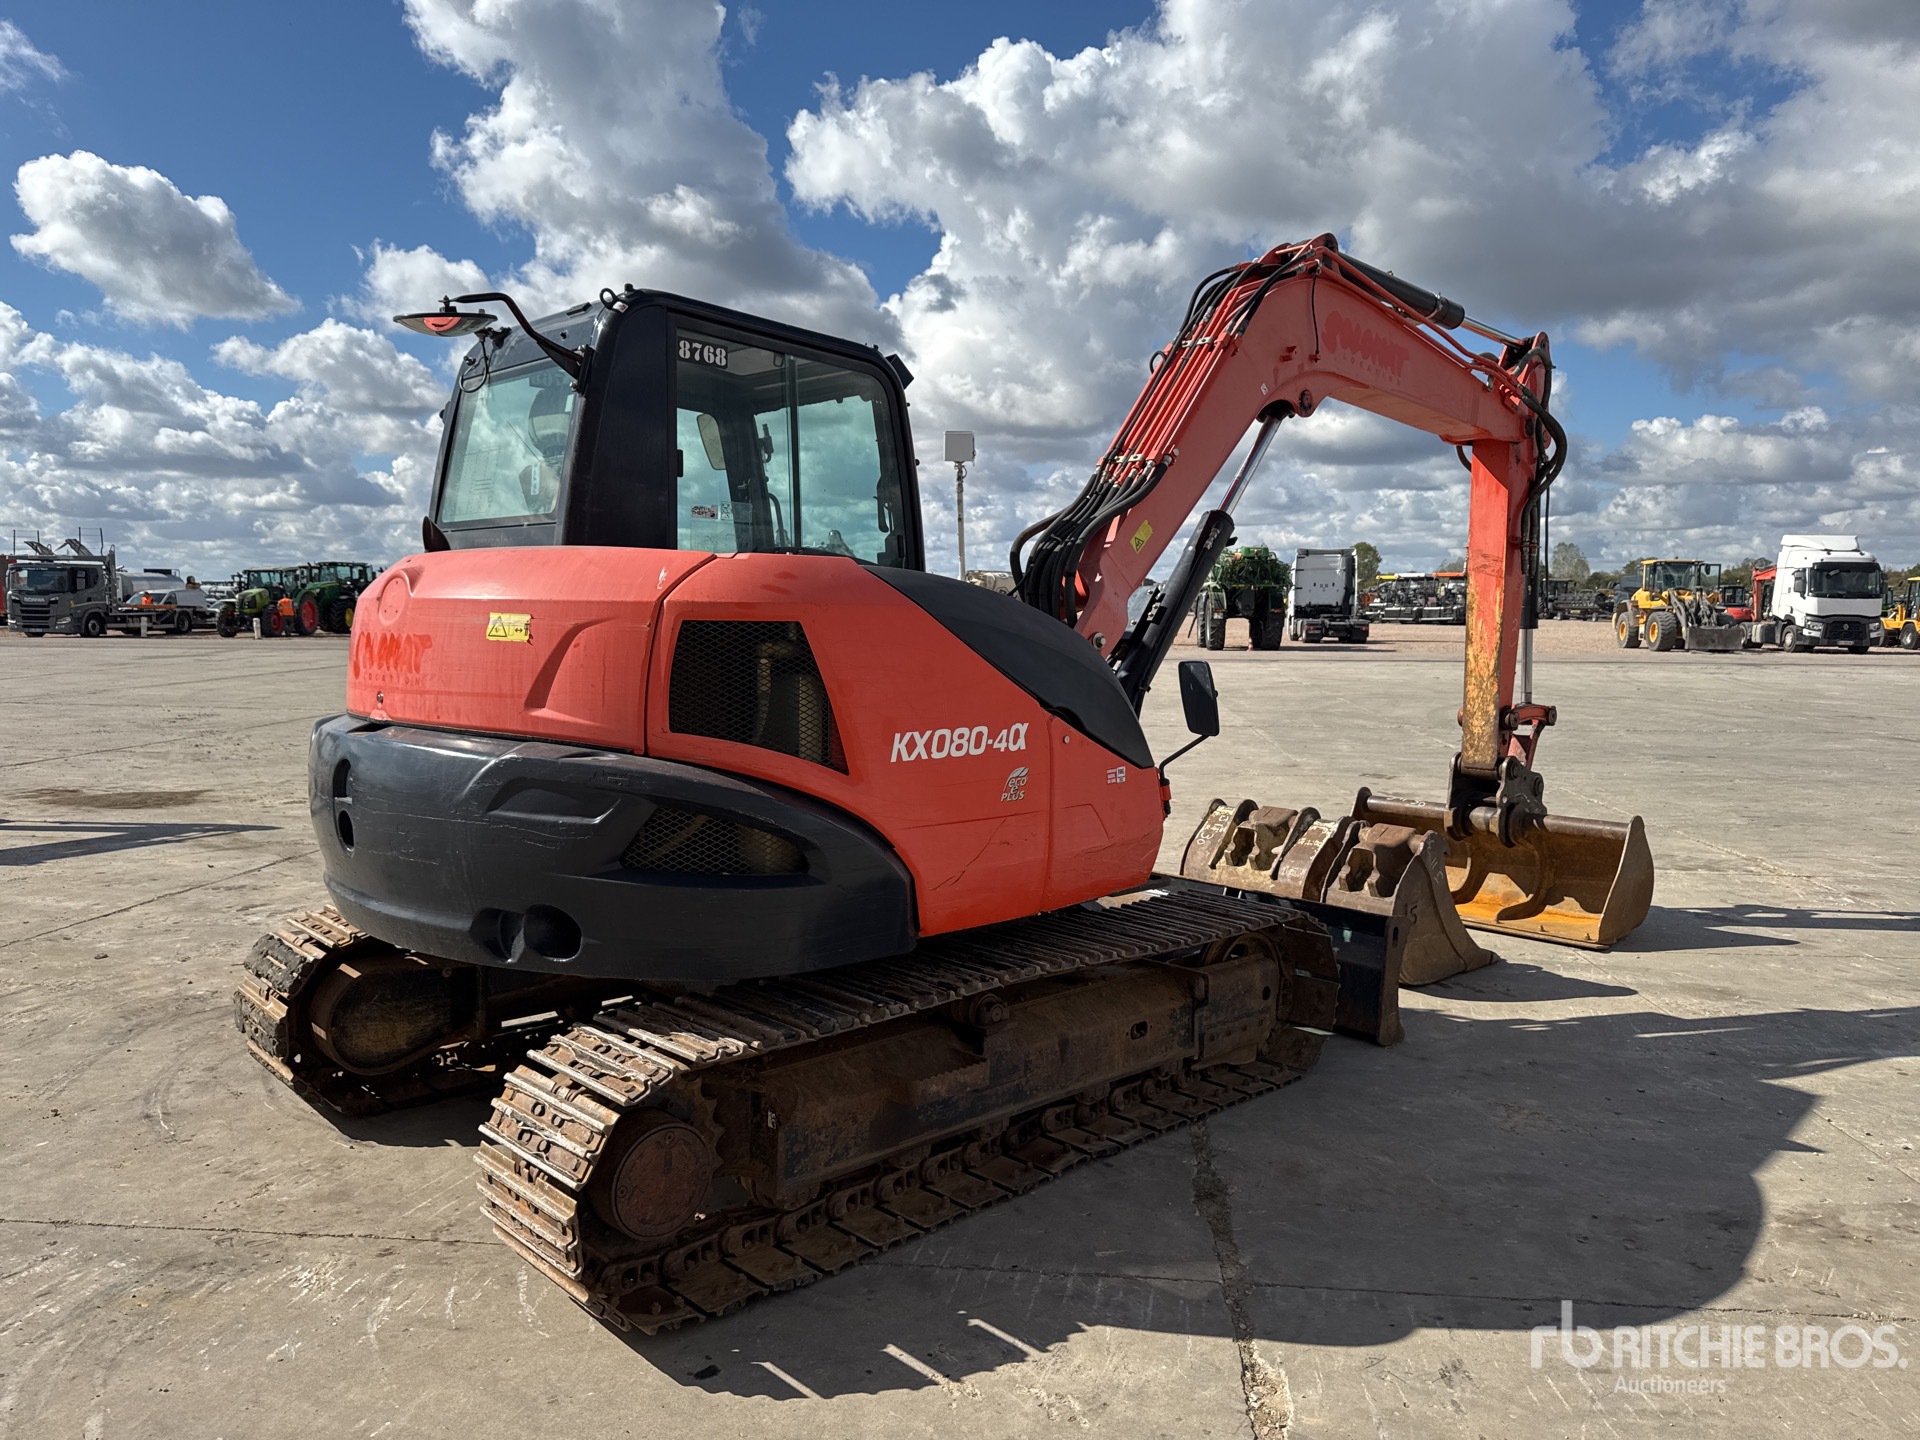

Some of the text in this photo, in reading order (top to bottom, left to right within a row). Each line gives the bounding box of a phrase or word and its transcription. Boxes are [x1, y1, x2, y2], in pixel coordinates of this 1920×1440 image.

[678, 339, 728, 367] 8768
[1008, 776, 1028, 788] eco
[1000, 790, 1025, 802] PLUS
